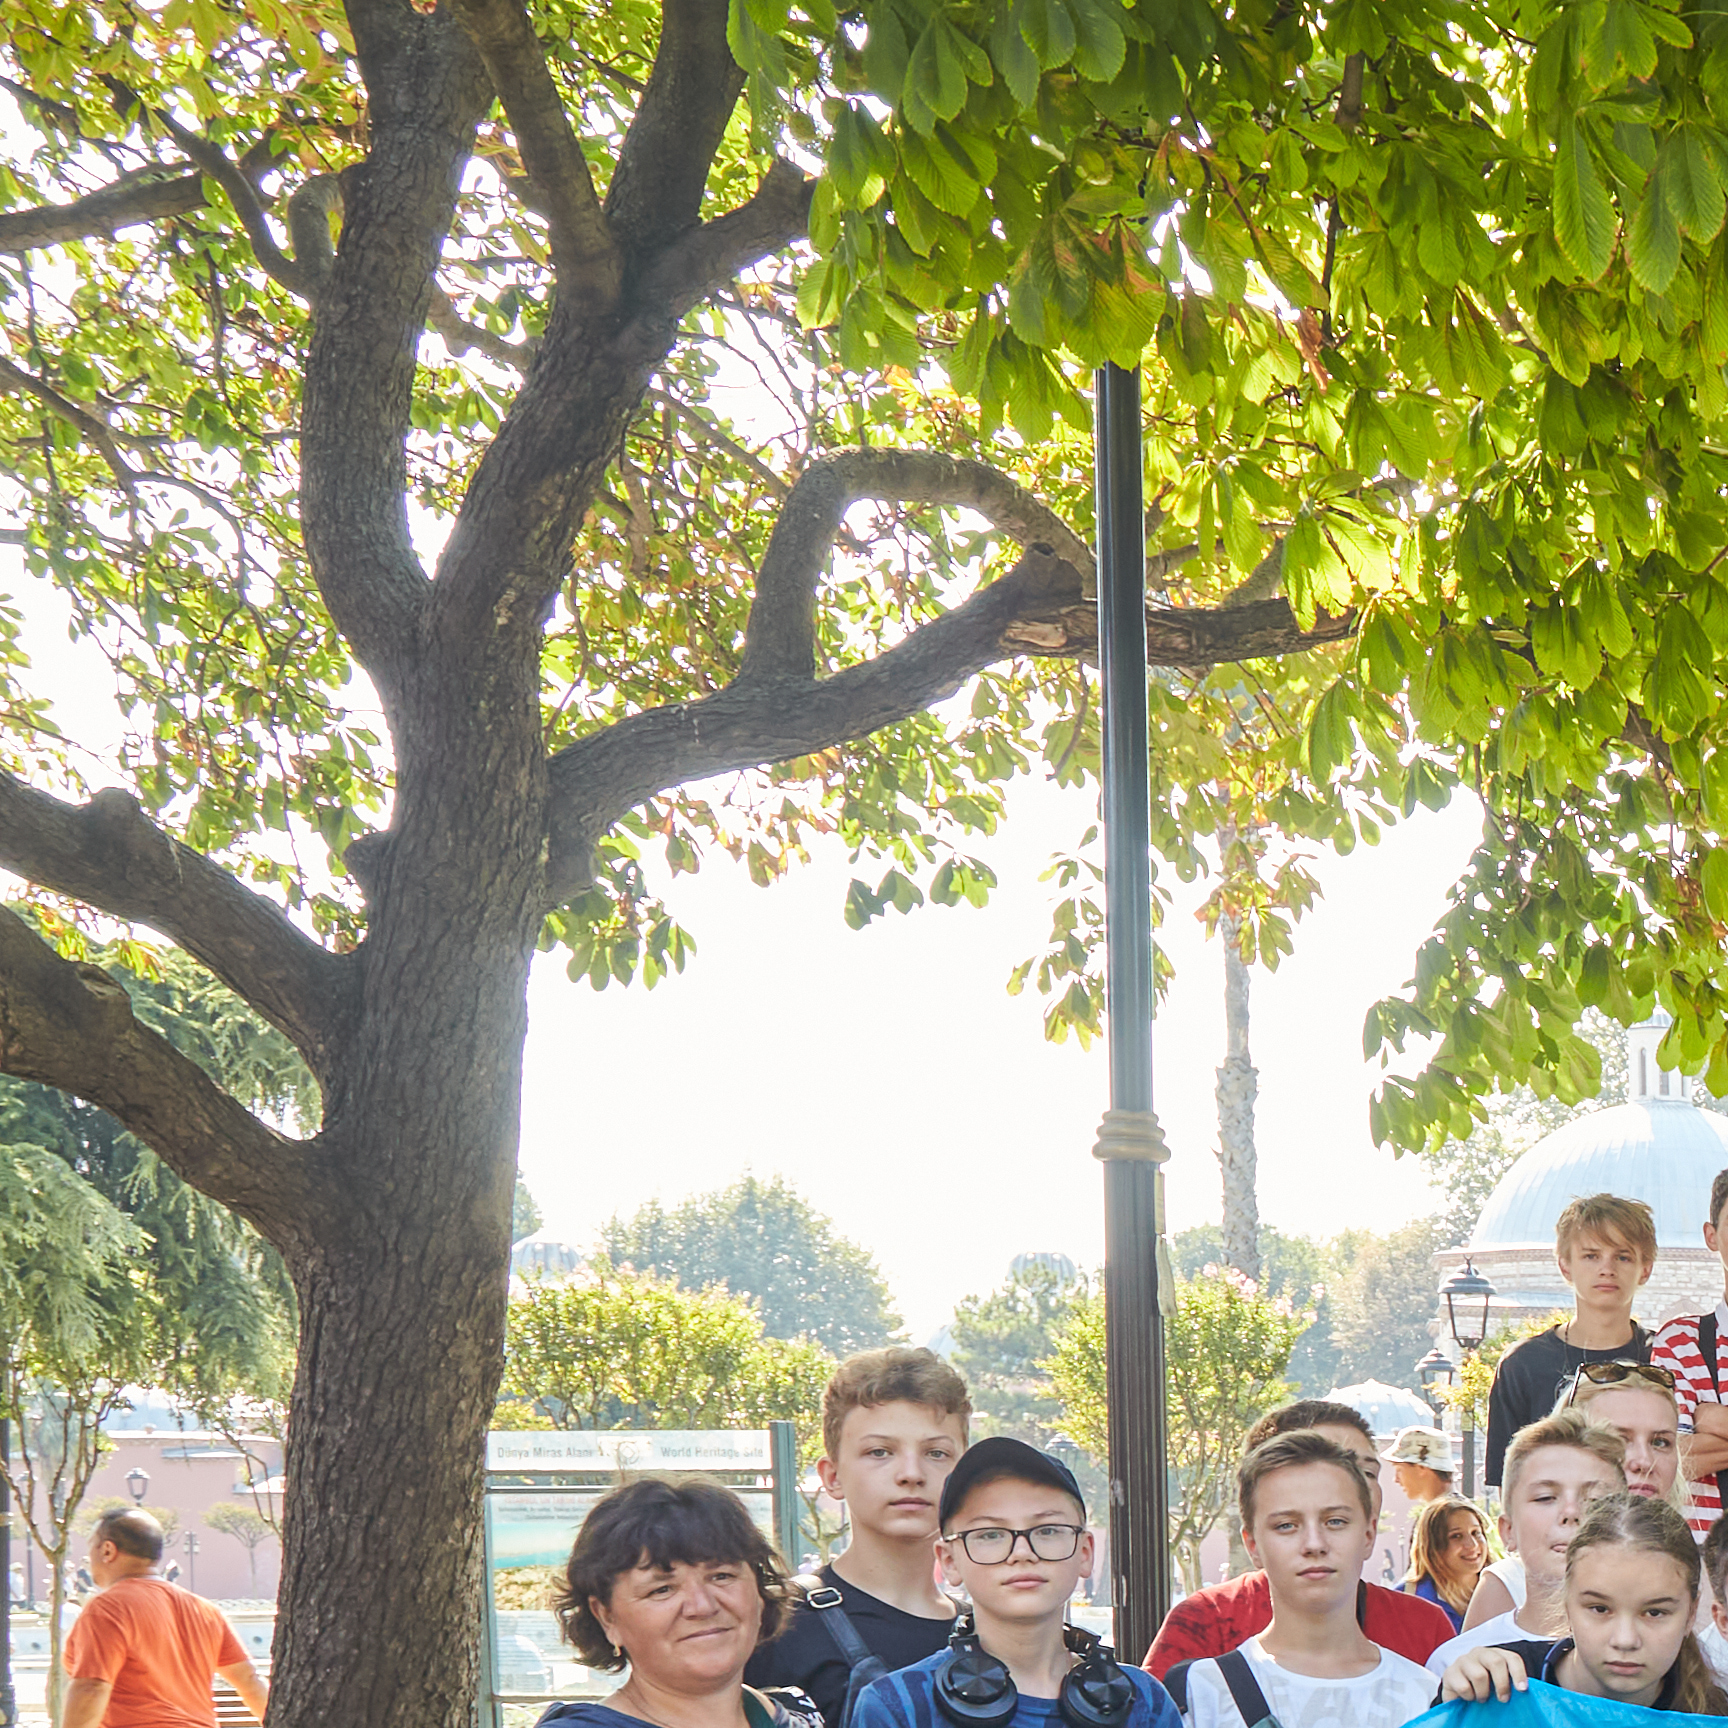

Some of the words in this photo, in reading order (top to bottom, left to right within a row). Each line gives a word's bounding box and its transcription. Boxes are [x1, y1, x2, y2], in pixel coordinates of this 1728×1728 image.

[497, 1446, 529, 1460] Dünya
[532, 1446, 562, 1458] Miras
[660, 1446, 691, 1458] World
[694, 1446, 740, 1460] Heritage
[743, 1446, 764, 1458] Site
